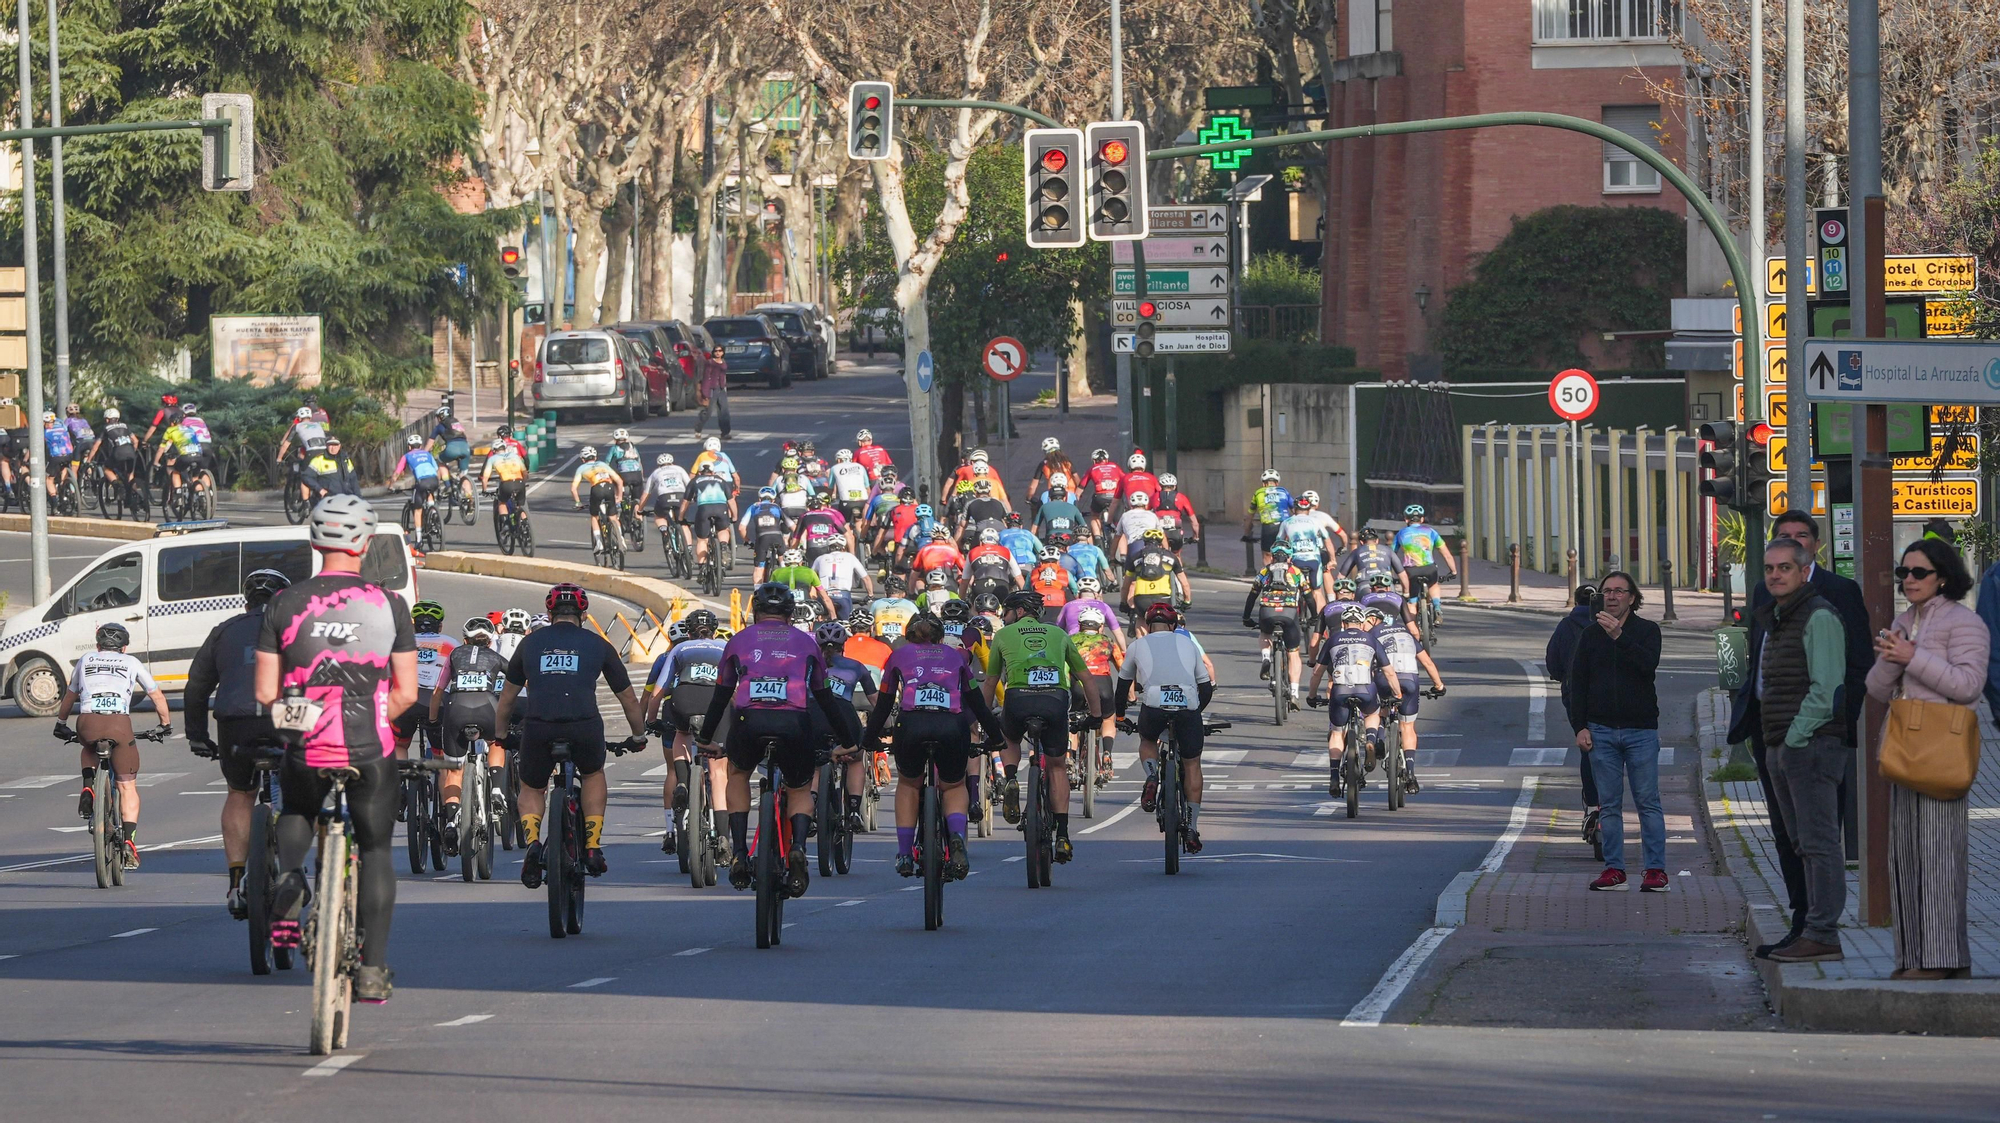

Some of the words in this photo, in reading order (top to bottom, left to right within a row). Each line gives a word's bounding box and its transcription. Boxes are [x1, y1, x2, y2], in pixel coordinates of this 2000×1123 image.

[1151, 210, 1186, 218] forestal
[1149, 219, 1185, 227] illares
[1828, 224, 1835, 234] 9
[1826, 248, 1840, 258] 10
[1827, 262, 1838, 272] 11
[1926, 262, 1972, 274] Crisol
[1147, 282, 1188, 290] rillante
[1827, 276, 1840, 288] 12
[1116, 302, 1191, 310] VILLCIOSA
[1866, 365, 1910, 383] Hospital
[1916, 366, 1928, 380] La
[1930, 366, 1980, 382] Arruzafa
[1562, 387, 1588, 403] 50
[1831, 408, 1913, 443] BS
[1906, 485, 1973, 496] Turísticos
[1904, 499, 1973, 512] Castilleja
[310, 622, 361, 641] FOX
[944, 624, 958, 632] 461
[418, 651, 432, 660] 454
[546, 656, 572, 667] 2413
[696, 666, 716, 677] 2402
[1032, 670, 1054, 682] 2452
[462, 676, 482, 684] 2445
[756, 682, 783, 694] 2447
[920, 690, 944, 703] 2448
[96, 698, 116, 708] 2464
[284, 705, 308, 724] 841
[378, 692, 390, 728] FOX
